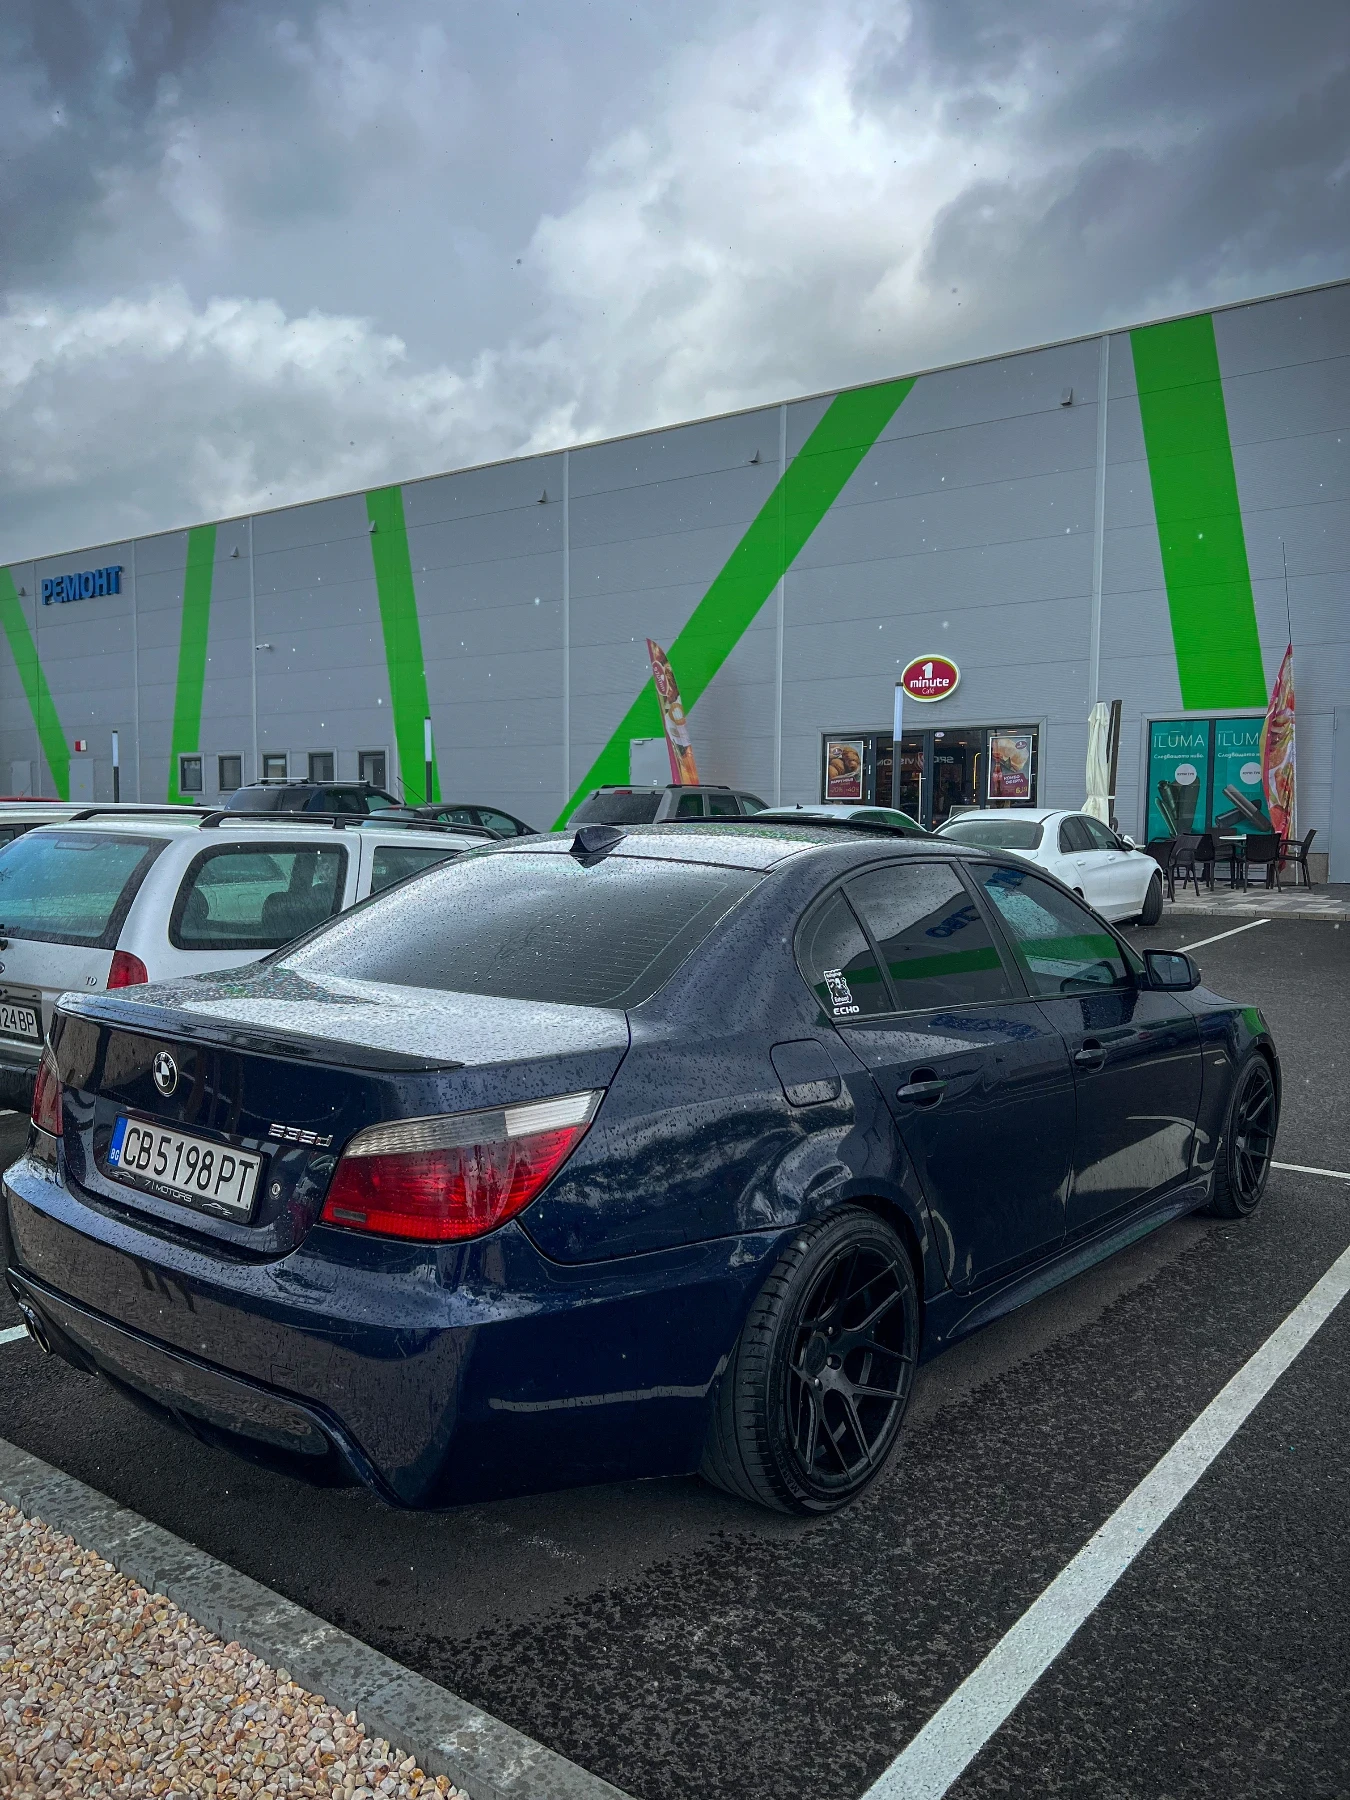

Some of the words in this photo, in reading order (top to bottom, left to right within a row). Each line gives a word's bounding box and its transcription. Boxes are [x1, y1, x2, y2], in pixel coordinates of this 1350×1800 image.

[41, 566, 122, 606] РЕМОНТ
[922, 661, 933, 678] 1
[910, 676, 950, 688] minute
[921, 687, 935, 695] Café
[1218, 732, 1259, 746] ILUM
[86, 976, 98, 986] TD
[833, 1005, 860, 1015] ECHO
[0, 1007, 34, 1032] 24BP
[268, 1123, 334, 1147] 535d
[110, 1147, 120, 1161] BG
[155, 1184, 193, 1203] MOTORS
